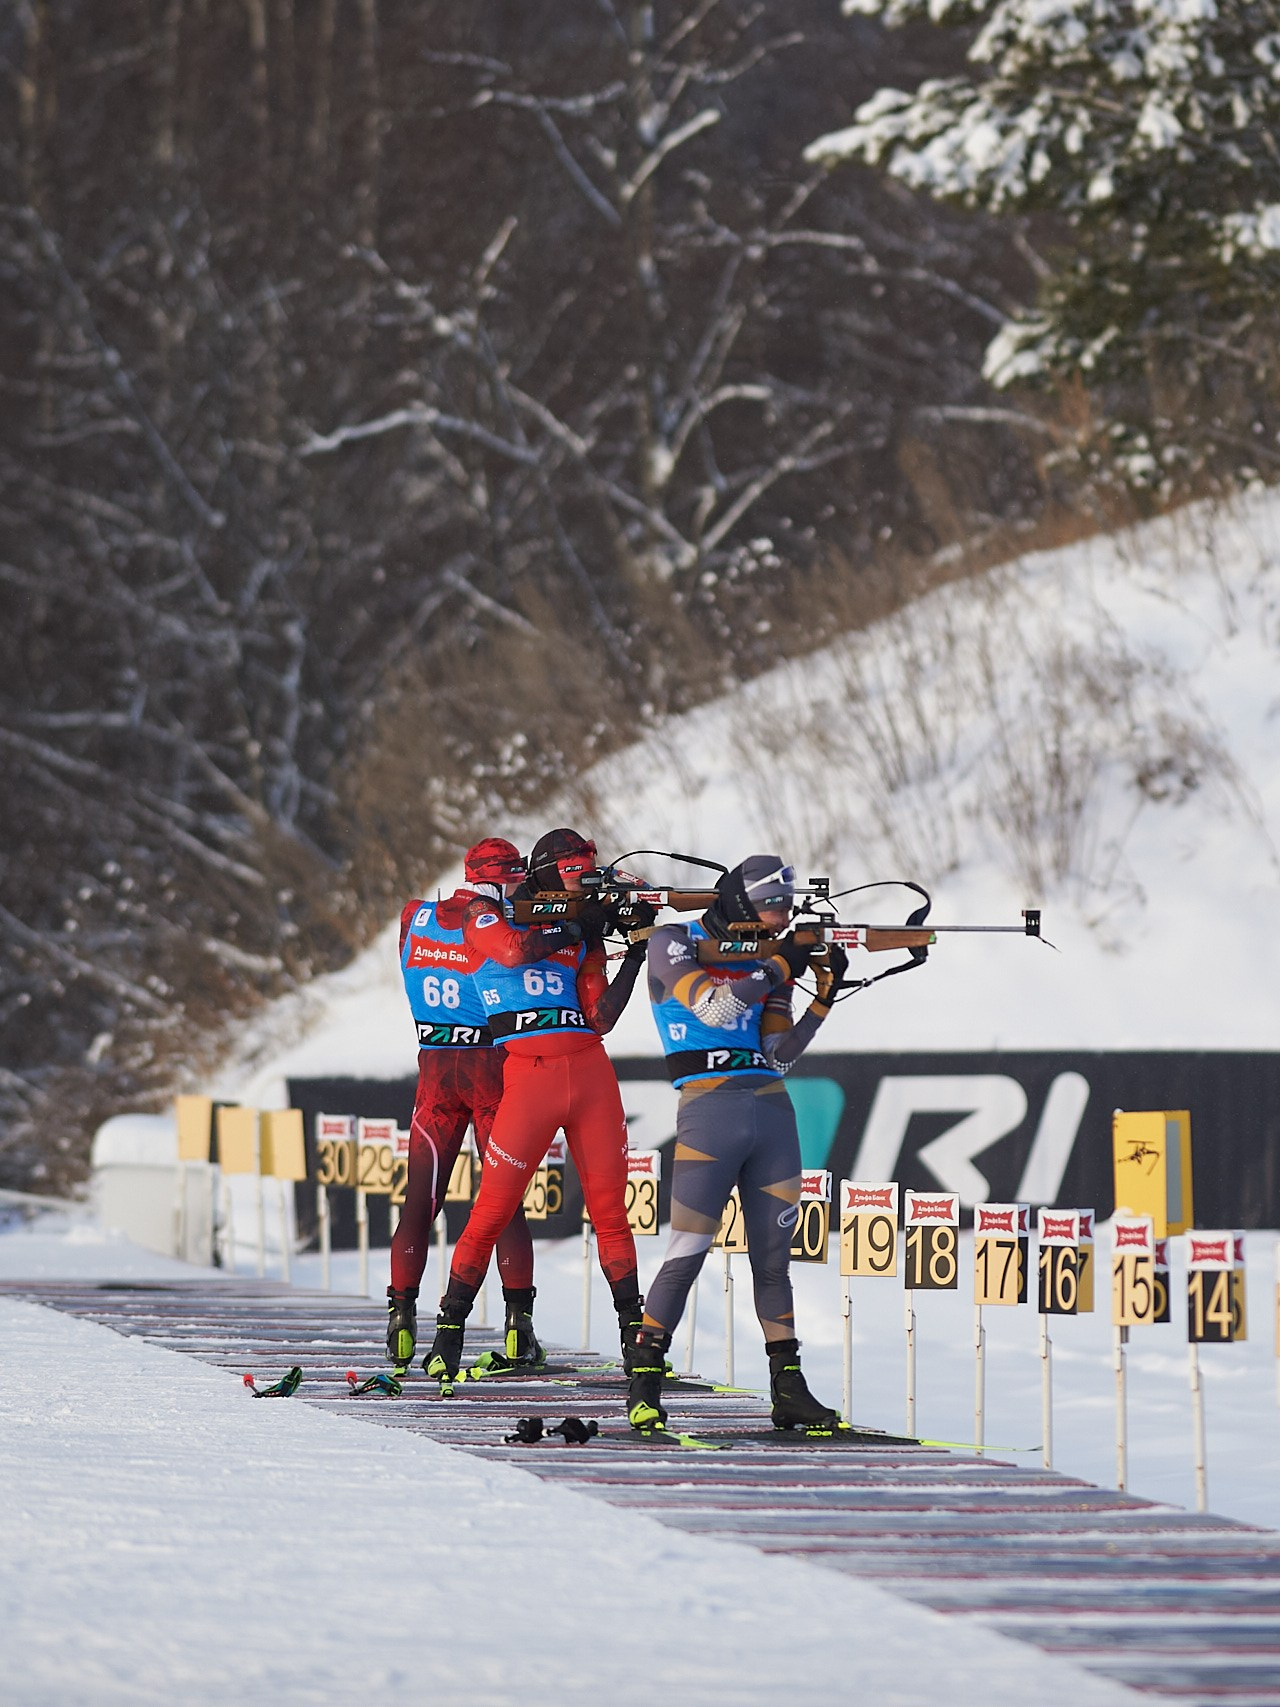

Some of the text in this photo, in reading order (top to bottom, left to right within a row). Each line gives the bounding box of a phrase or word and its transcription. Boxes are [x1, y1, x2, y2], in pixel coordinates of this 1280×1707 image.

[532, 903, 567, 914] PARI
[618, 907, 633, 915] RI
[414, 945, 469, 963] Альфа Бан
[557, 948, 575, 957] анк
[719, 941, 758, 953] PARI
[423, 975, 461, 1009] 68
[482, 988, 501, 1006] 65
[522, 968, 564, 996] 65
[418, 1024, 481, 1044] PARI
[668, 1023, 687, 1040] 67
[707, 1050, 768, 1069] PAR
[316, 1140, 350, 1185] 30
[360, 1145, 394, 1186] 29
[447, 1150, 470, 1194] 7
[485, 1150, 498, 1168] РАЙ
[391, 1158, 409, 1202] 2
[547, 1169, 562, 1213] 6
[627, 1179, 655, 1230] 23
[854, 1193, 872, 1203] Альфа
[917, 1204, 948, 1215] Альфа Банк
[790, 1200, 825, 1257] 20
[843, 1215, 895, 1272] 19
[906, 1225, 957, 1286] 18
[976, 1239, 1016, 1299] 17
[1039, 1245, 1077, 1311] 16
[1114, 1255, 1151, 1319] 15
[1188, 1270, 1233, 1338] 14
